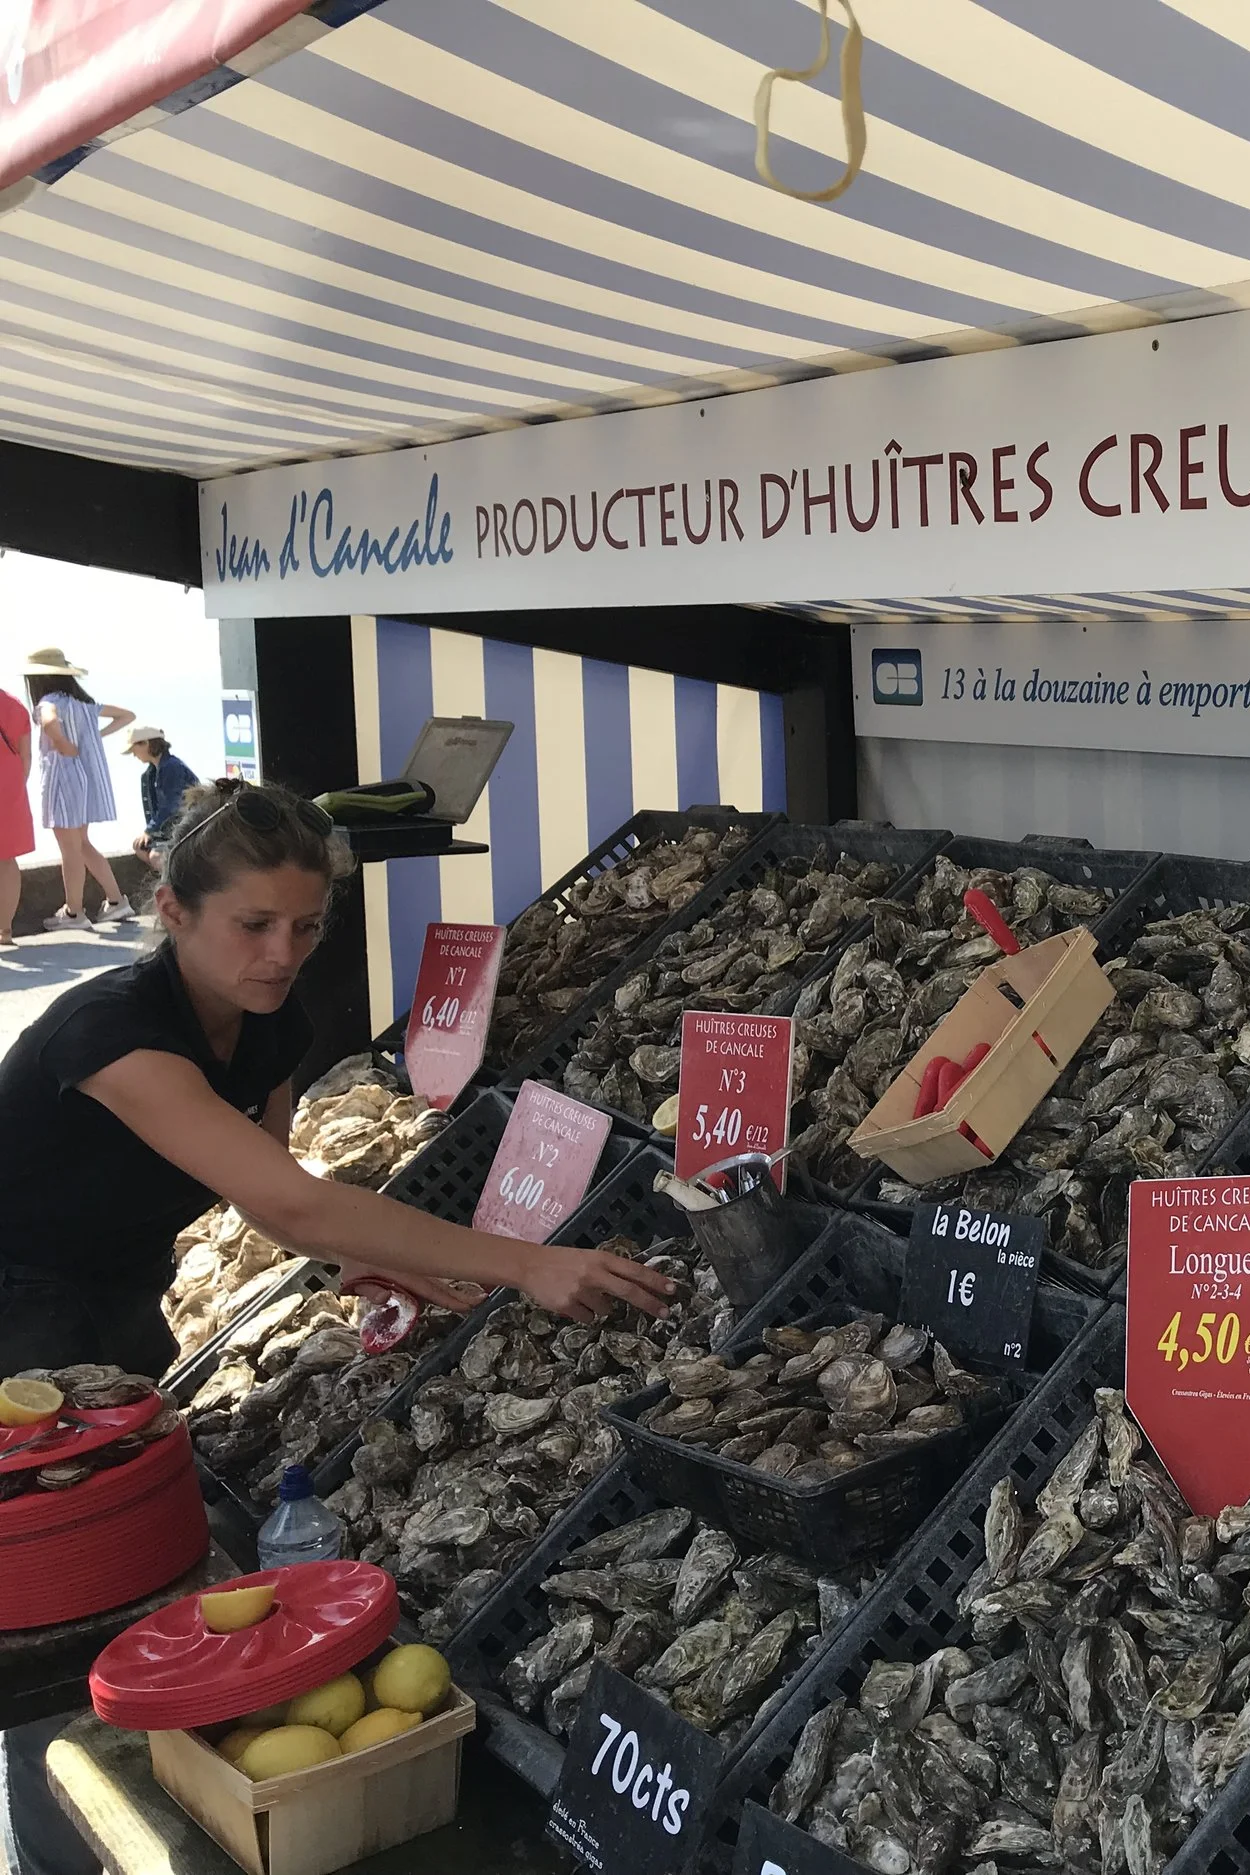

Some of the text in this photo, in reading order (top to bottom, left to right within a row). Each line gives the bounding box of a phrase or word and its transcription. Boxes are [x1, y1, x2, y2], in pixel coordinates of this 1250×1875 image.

[476, 478, 744, 558] PRODUCTEUR
[760, 439, 1053, 539] D'HUÎTRES
[216, 473, 454, 582] Jean d'Cancale
[876, 662, 918, 695] CB
[941, 668, 965, 700] 13
[973, 668, 987, 701] à
[994, 668, 1016, 702] la
[1023, 668, 1130, 705] douzaine
[1137, 671, 1151, 706] à
[434, 927, 494, 943] HUÎTRES CREUSES
[439, 945, 483, 958] DE CANCALE
[422, 995, 460, 1031] 6,40
[695, 1018, 777, 1039] HUÎTRES CREUSES
[705, 1040, 764, 1058] DE CANCALE
[529, 1090, 598, 1131] HUÎTRES CREUSES
[532, 1112, 582, 1144] DE CANCALE
[692, 1104, 742, 1150] 5,40
[499, 1166, 545, 1211] 6,00
[1152, 1186, 1217, 1207] HUÎTRES
[931, 1205, 1012, 1247] la Belon
[1170, 1215, 1189, 1233] DE
[997, 1249, 1035, 1268] la pièce
[947, 1269, 976, 1306] 1€
[1157, 1311, 1240, 1372] 4,50
[591, 1713, 690, 1835] 70cts
[568, 1818, 577, 1828] en
[577, 1819, 600, 1849] France
